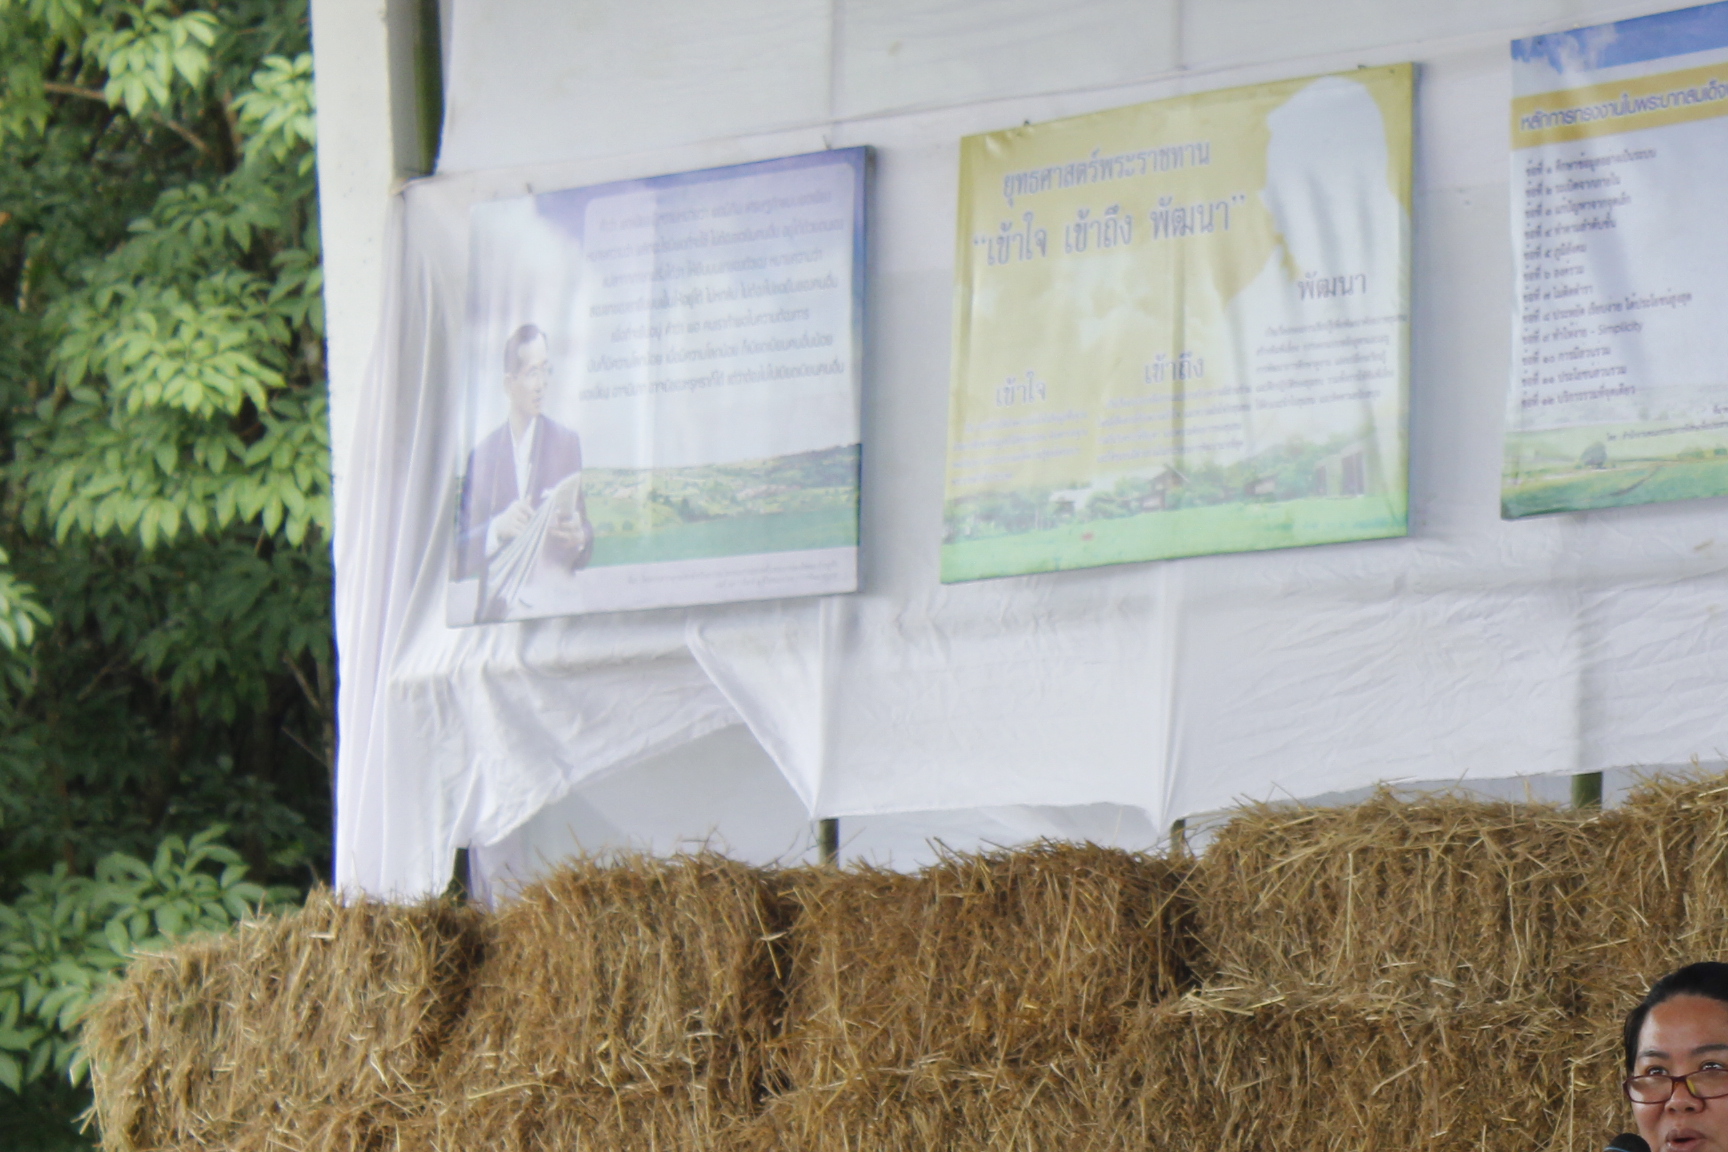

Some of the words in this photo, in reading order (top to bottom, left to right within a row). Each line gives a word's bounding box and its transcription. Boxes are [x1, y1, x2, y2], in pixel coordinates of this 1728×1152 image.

[1003, 142, 1211, 208] ยุทธศาสตร์พระราชทาน
[1064, 204, 1134, 255] เข้าถึง
[1298, 271, 1368, 301] พัฒนา
[1144, 351, 1206, 386] เข้าถึง
[996, 369, 1047, 408] เข้าใจ
